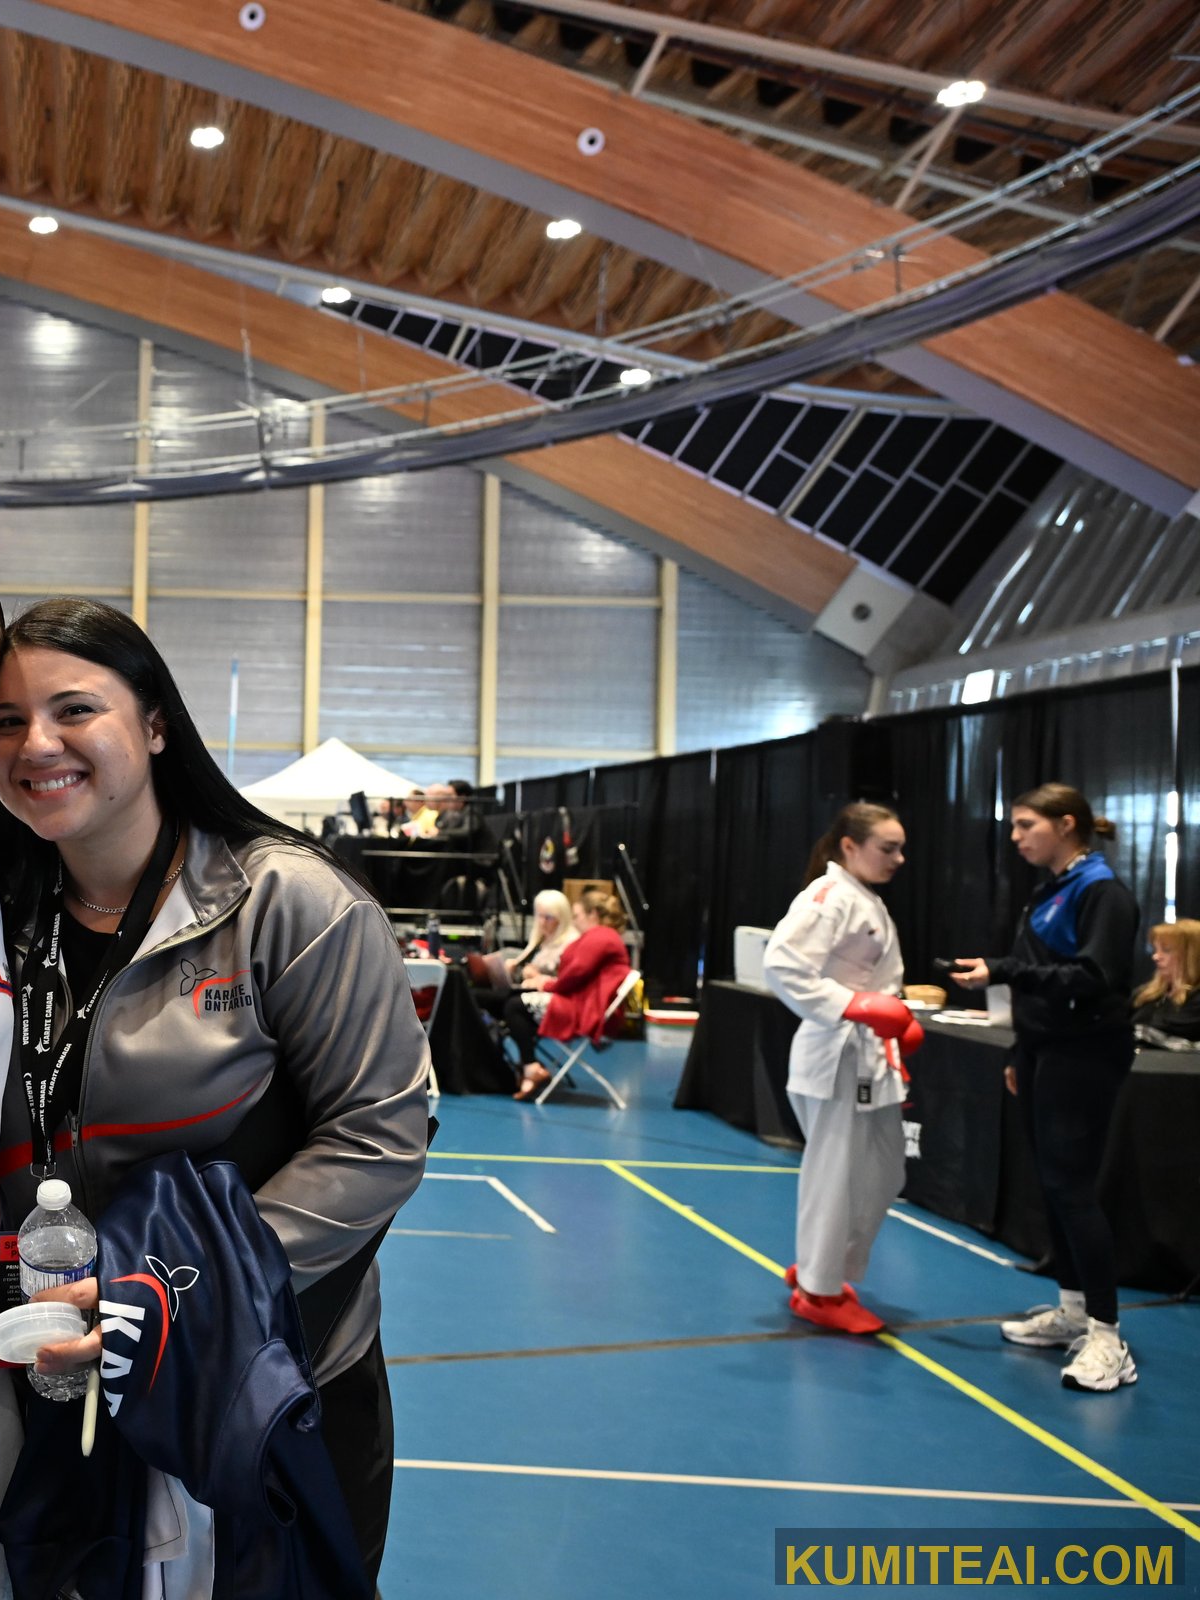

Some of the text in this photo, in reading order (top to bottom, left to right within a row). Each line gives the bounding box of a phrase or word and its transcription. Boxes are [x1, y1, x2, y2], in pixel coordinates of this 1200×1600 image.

[50, 936, 58, 959] KARATE
[205, 984, 245, 1000] KARATE
[205, 995, 252, 1011] ONTARIO
[21, 993, 29, 1018] KARATE
[43, 991, 54, 1045] KARATE CANADA
[48, 1043, 72, 1096] KARATE CANADA
